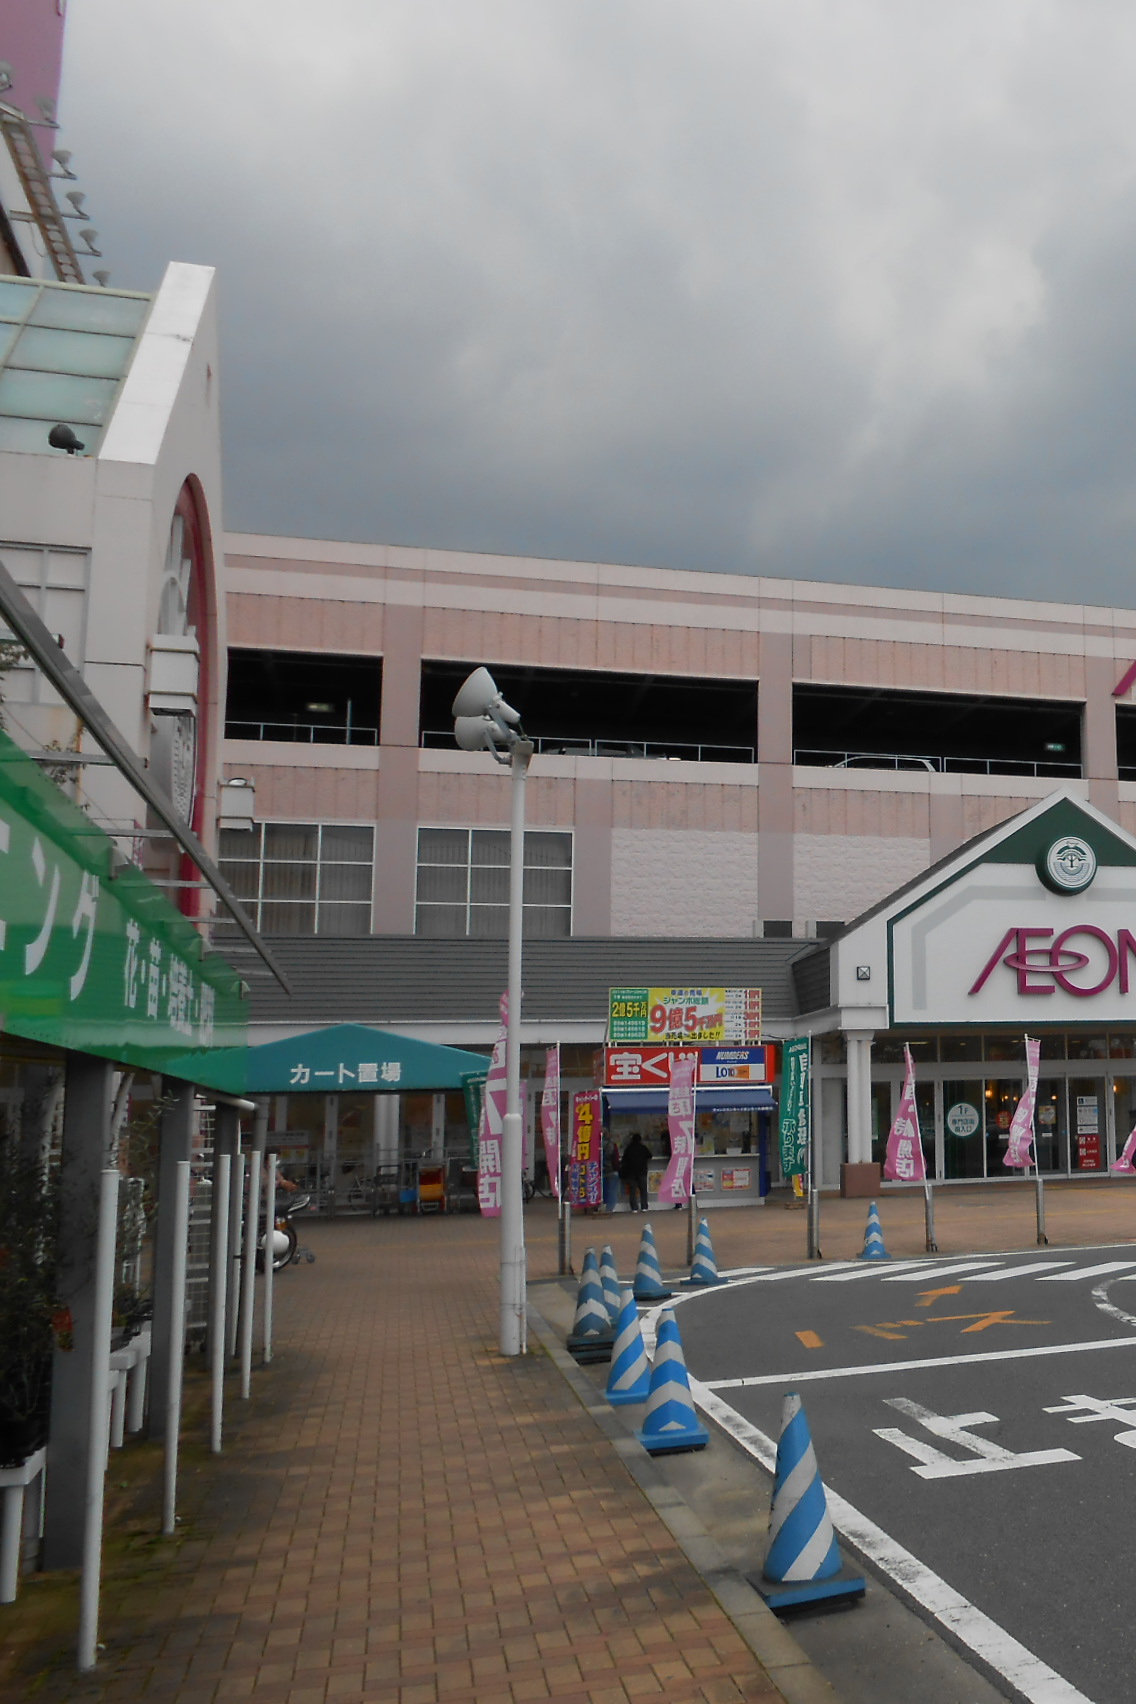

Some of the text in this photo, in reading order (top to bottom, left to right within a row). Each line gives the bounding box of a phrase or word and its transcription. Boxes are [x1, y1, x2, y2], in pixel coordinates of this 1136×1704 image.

[715, 1051, 749, 1060] NUMBERS
[289, 1062, 402, 1084] カート置場
